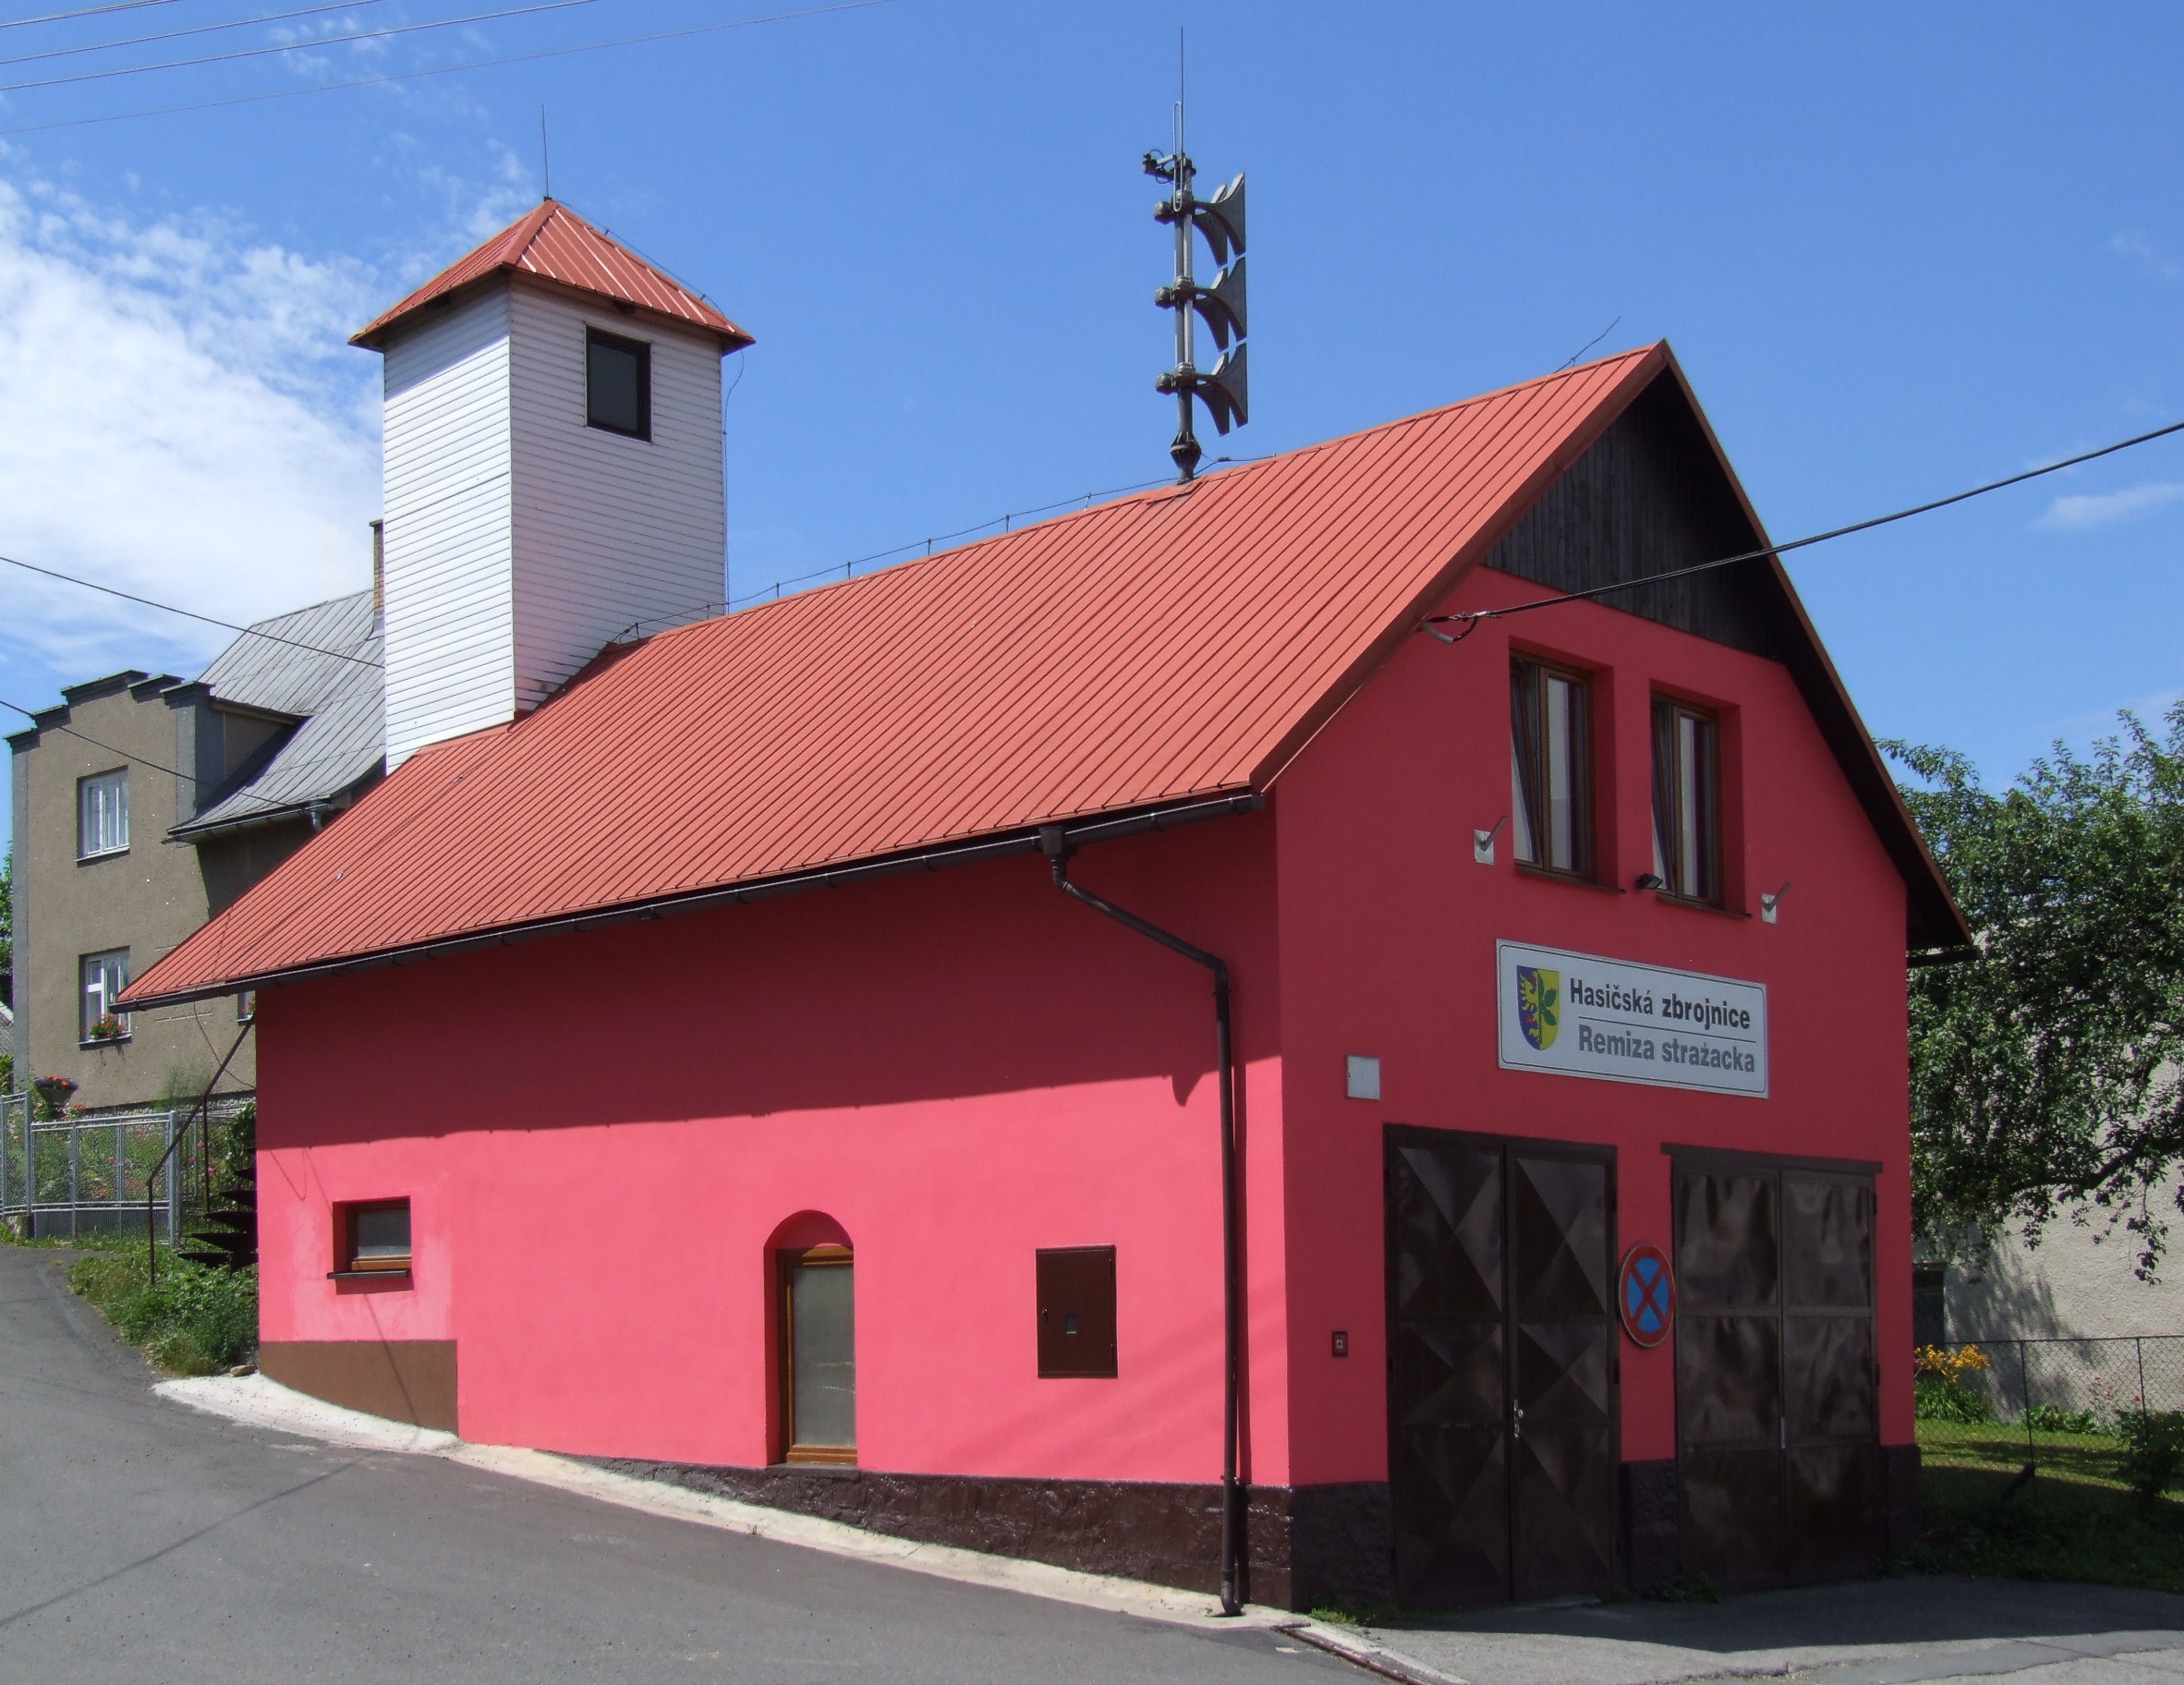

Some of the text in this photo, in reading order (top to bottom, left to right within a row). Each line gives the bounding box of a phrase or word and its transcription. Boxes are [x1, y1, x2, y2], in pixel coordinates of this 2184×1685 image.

[1570, 977, 1751, 1030] Hasičská zbrojnice
[1578, 1024, 1755, 1073] Remiza strażacka
